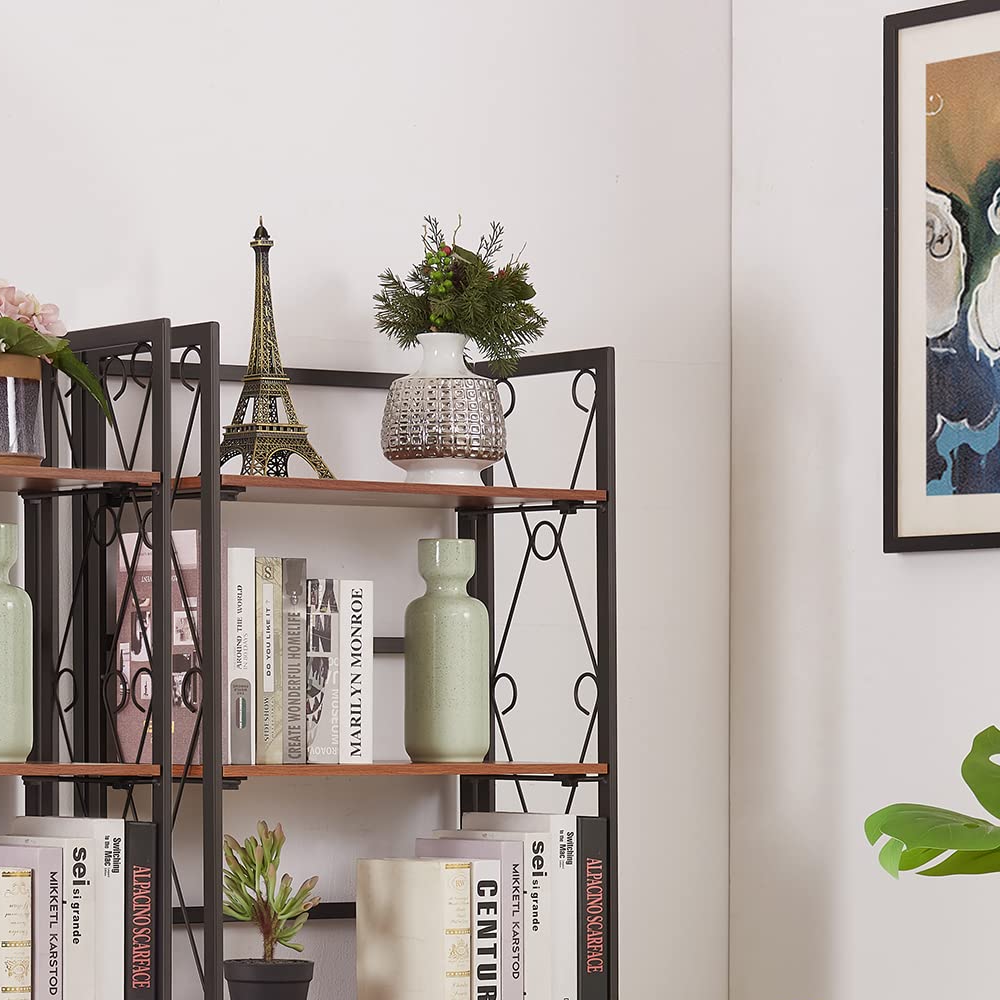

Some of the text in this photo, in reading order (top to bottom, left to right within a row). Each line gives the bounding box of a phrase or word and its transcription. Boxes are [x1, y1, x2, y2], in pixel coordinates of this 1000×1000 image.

[265, 607, 271, 616] IT
[266, 664, 272, 677] DO
[287, 612, 301, 760] CREATE WONDERFUL HOMELIFE
[350, 588, 363, 757] MARILYN MONROE
[71, 847, 91, 945] sei si grande
[104, 850, 112, 867] Mac
[111, 837, 122, 874] Switching
[531, 840, 548, 932] sei si grande
[565, 831, 574, 865] Switching
[49, 871, 59, 996] MIKKETL KARSTOD
[132, 865, 152, 989] ALPACINO SCARFACE
[511, 864, 520, 980] MIKKETL KARSTOD
[586, 858, 603, 973] ALPACINO SCARFACE
